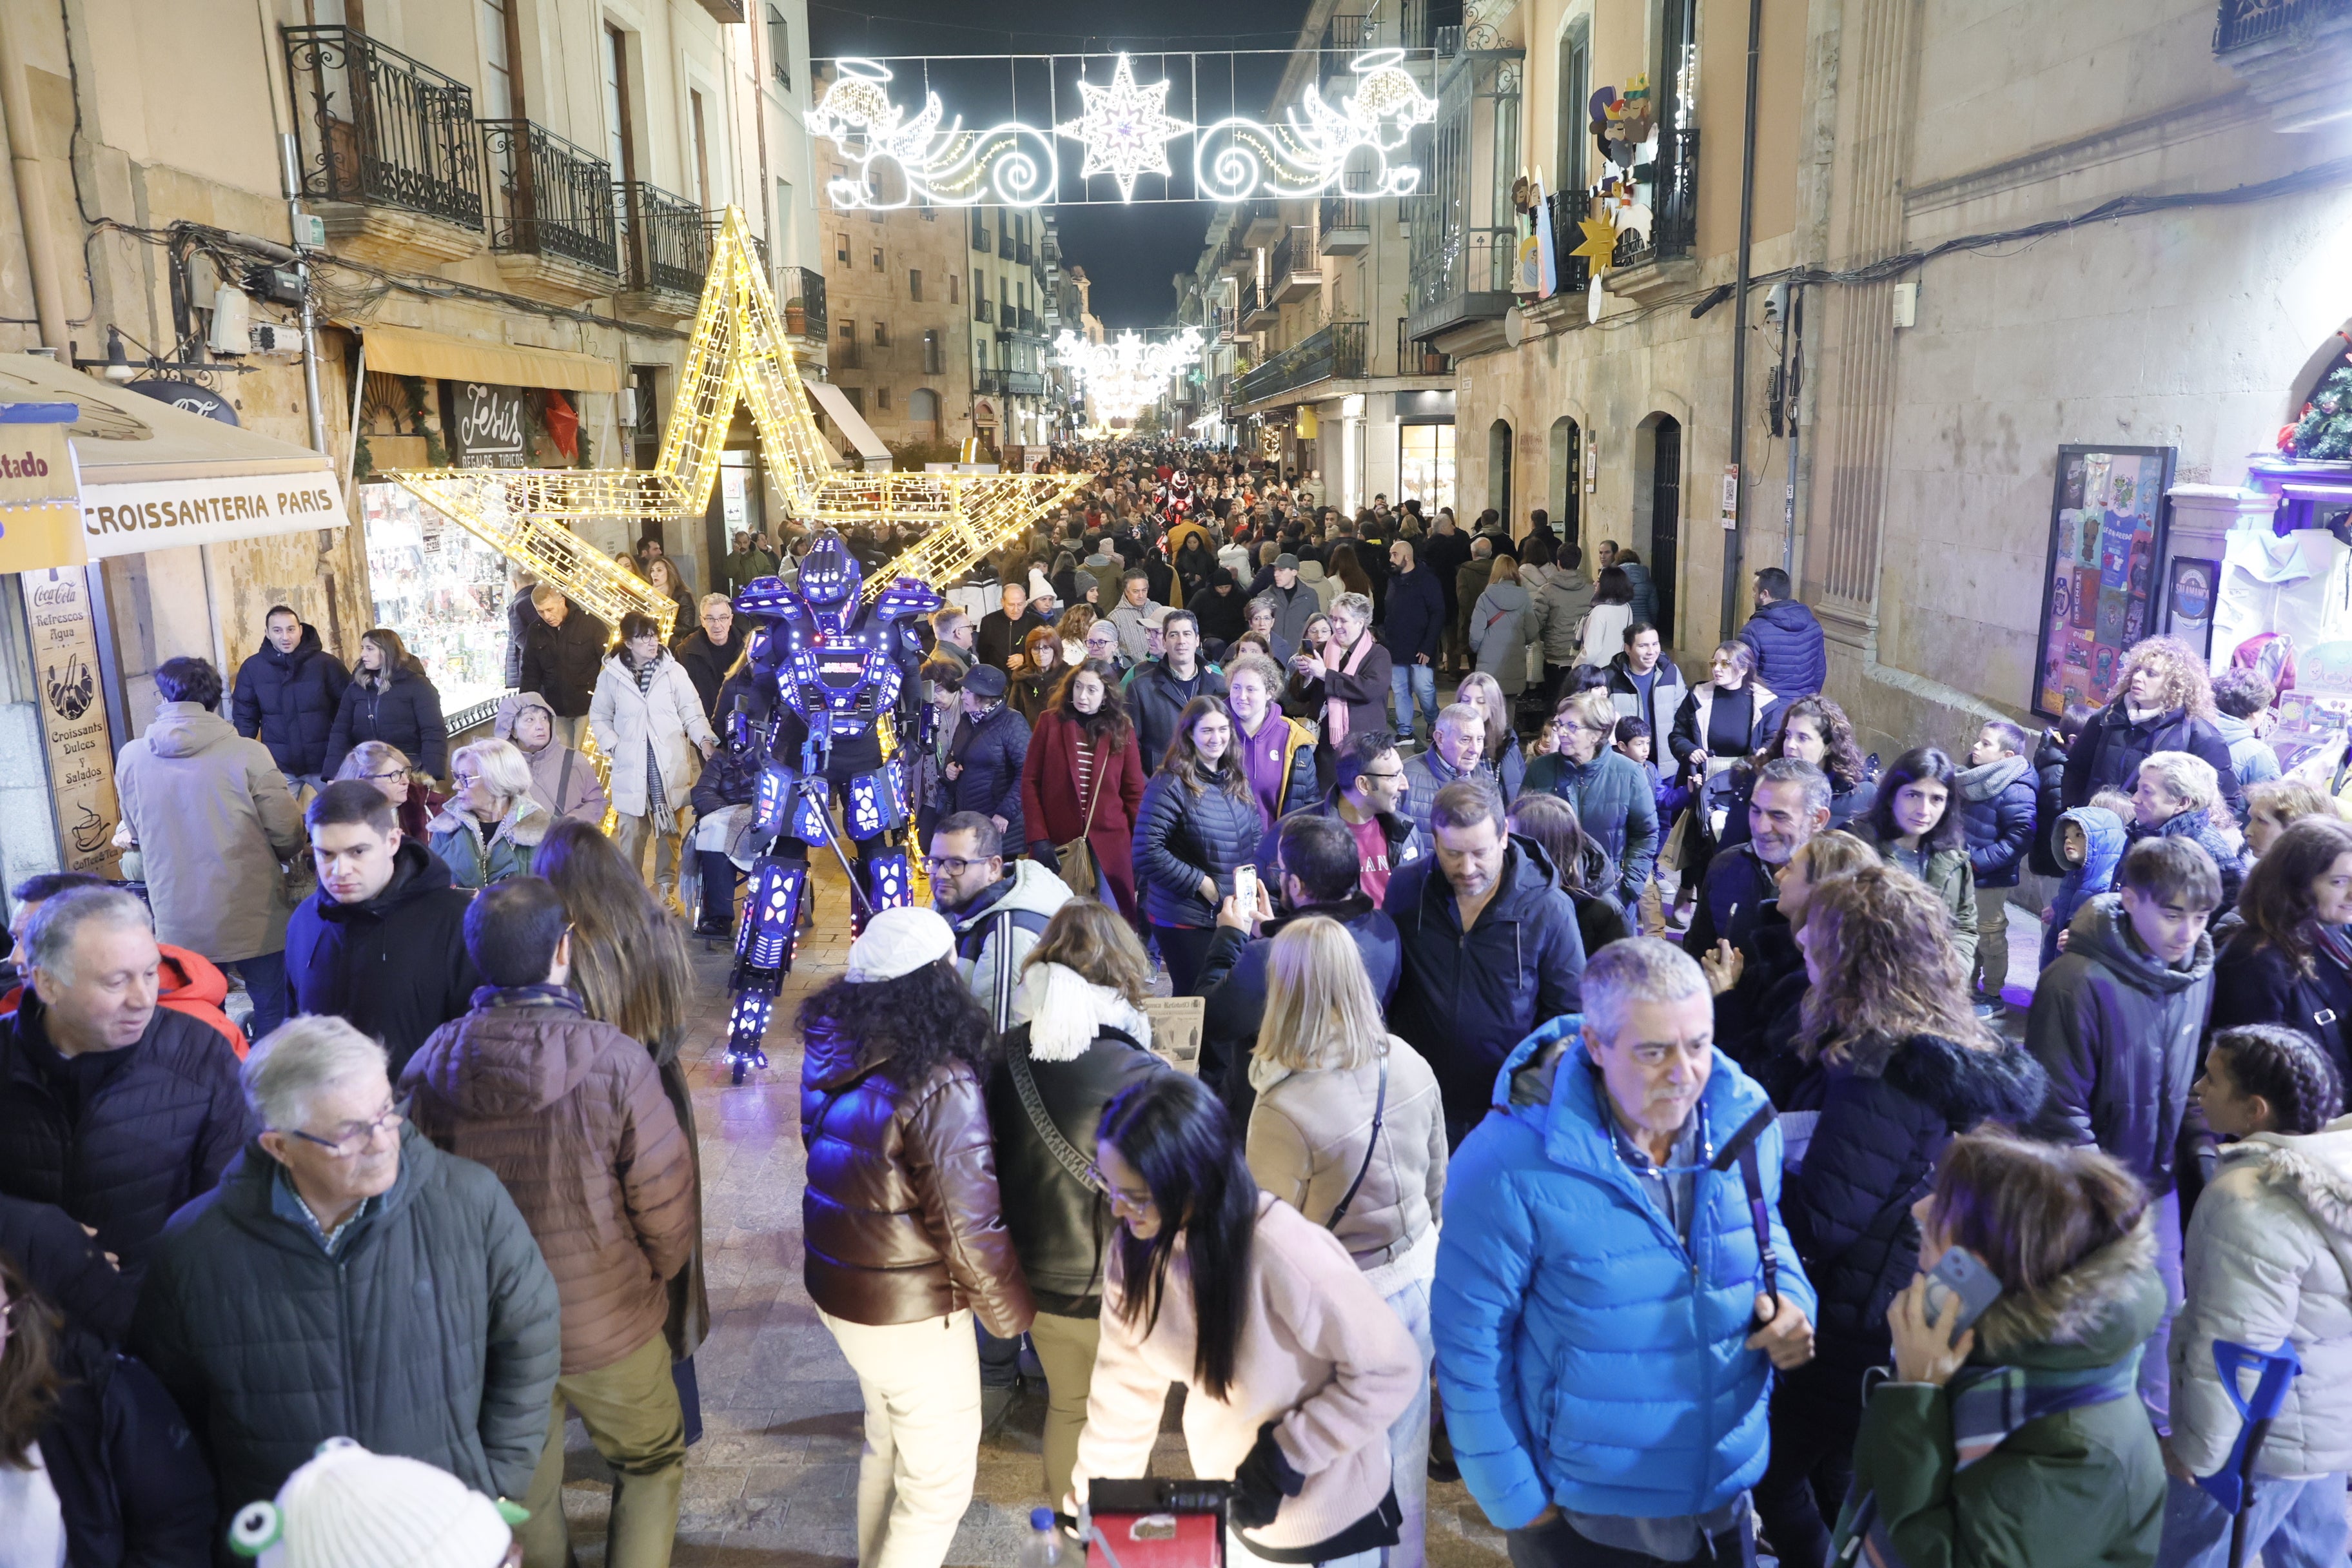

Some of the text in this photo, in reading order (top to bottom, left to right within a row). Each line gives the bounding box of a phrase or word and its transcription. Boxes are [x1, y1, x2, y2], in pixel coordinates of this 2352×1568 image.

[462, 383, 523, 447] Jesús
[0, 451, 48, 478] tado
[85, 489, 333, 535] CROISSANTERIA PARIS
[35, 612, 84, 627] Refrescos
[50, 628, 75, 642] Agua
[52, 723, 103, 743] Croissants
[63, 740, 95, 755] Dulces
[79, 757, 85, 767] y
[66, 767, 102, 785] Salados
